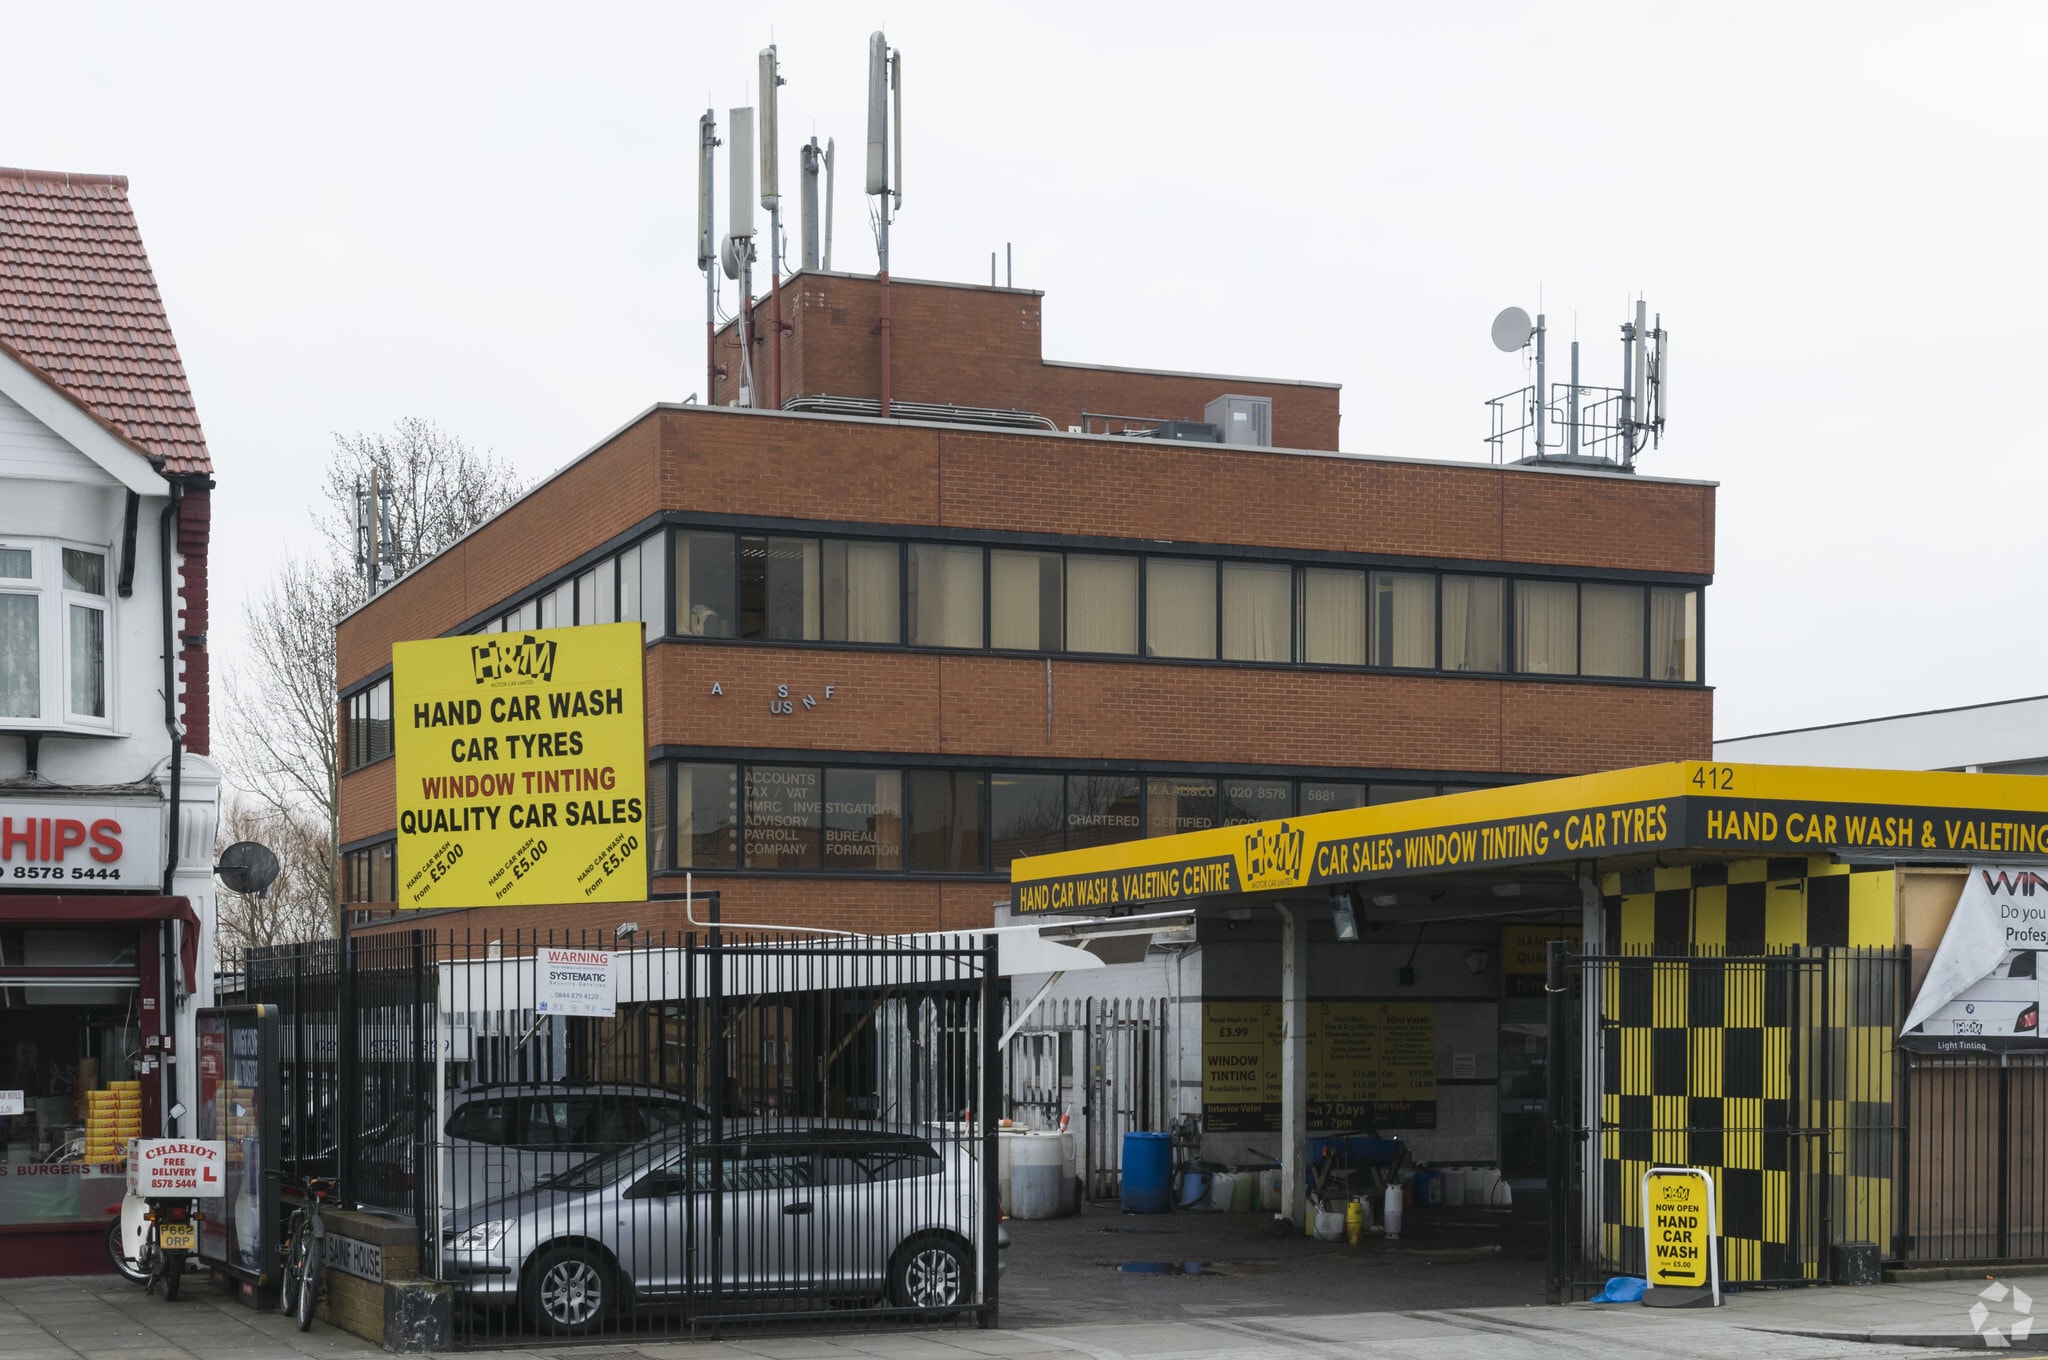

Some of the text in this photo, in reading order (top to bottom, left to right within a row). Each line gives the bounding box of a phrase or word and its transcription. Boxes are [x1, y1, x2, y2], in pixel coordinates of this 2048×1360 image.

[472, 634, 557, 684] H&M
[711, 681, 723, 695] A
[778, 684, 789, 698] S
[825, 686, 835, 699] F
[414, 688, 623, 729] HAND CAR WASH
[769, 701, 793, 714] US
[451, 731, 584, 763] CAR TYRES
[422, 766, 616, 800] WINDOW TINTING
[744, 773, 816, 785] ACCOUNTS
[1692, 767, 1734, 790] 412
[745, 786, 768, 798] TAX
[786, 788, 808, 799] VAT
[1230, 787, 1252, 798] 020
[1258, 788, 1286, 799] 8578
[1308, 790, 1335, 801] 5881
[744, 801, 899, 816] HMRC INVESTIGATIONS
[401, 798, 643, 835] QUALITY CAR SALES
[744, 815, 809, 828] ADVISORY
[1068, 814, 1212, 828] CHARTERED CERTIFIED
[744, 829, 877, 842] PAYROLL BUREAU
[1707, 810, 1778, 842] HAND
[1786, 813, 1838, 844] CAR
[1845, 816, 1914, 847] WASH
[1921, 820, 1937, 848] &
[2, 817, 124, 864] HIPS
[1317, 804, 1668, 877] CAR SALES WINDOW TINTING CAR TYRES
[745, 843, 899, 857] COMPANY FORMATION
[1245, 821, 1305, 882] H&M
[406, 841, 451, 889] HAND CAR WASH
[488, 837, 535, 886] HAND CAR WASH
[577, 833, 625, 883] HAND CAR WASH
[413, 843, 464, 902] from £5.00
[496, 840, 548, 900] from £5.00
[585, 835, 639, 896] from £5.00
[14, 866, 65, 879] 8578
[71, 867, 121, 880] 5444
[1020, 862, 1230, 912] HAND CAR WASH & VALETING CENTRE
[2001, 905, 2046, 923] Do you
[548, 951, 608, 964] WARNING
[550, 971, 606, 982] SYSTEMATIC
[1264, 1004, 1271, 1016] 2
[1323, 1004, 1329, 1016] 3
[1219, 1027, 1248, 1037] £3.99
[1938, 1042, 1986, 1051] Light Tinting
[1208, 1056, 1258, 1066] WINDOW
[1210, 1071, 1256, 1081] TINTING
[1208, 1104, 1239, 1112] Interior
[1337, 1104, 1367, 1118] Days
[145, 1144, 217, 1160] CHARIOT
[163, 1158, 185, 1166] FREE
[17, 1164, 90, 1176] BURGERS
[152, 1168, 197, 1177] DELIVERY
[203, 1166, 218, 1182] L
[151, 1179, 197, 1188] 8578 5444
[1656, 1204, 1699, 1213] NOW OPEN
[1658, 1215, 1698, 1229] HAND
[161, 1225, 194, 1235] P662
[1663, 1230, 1692, 1243] CAR
[1656, 1245, 1698, 1259] WASH
[353, 1243, 380, 1278] HOUSE
